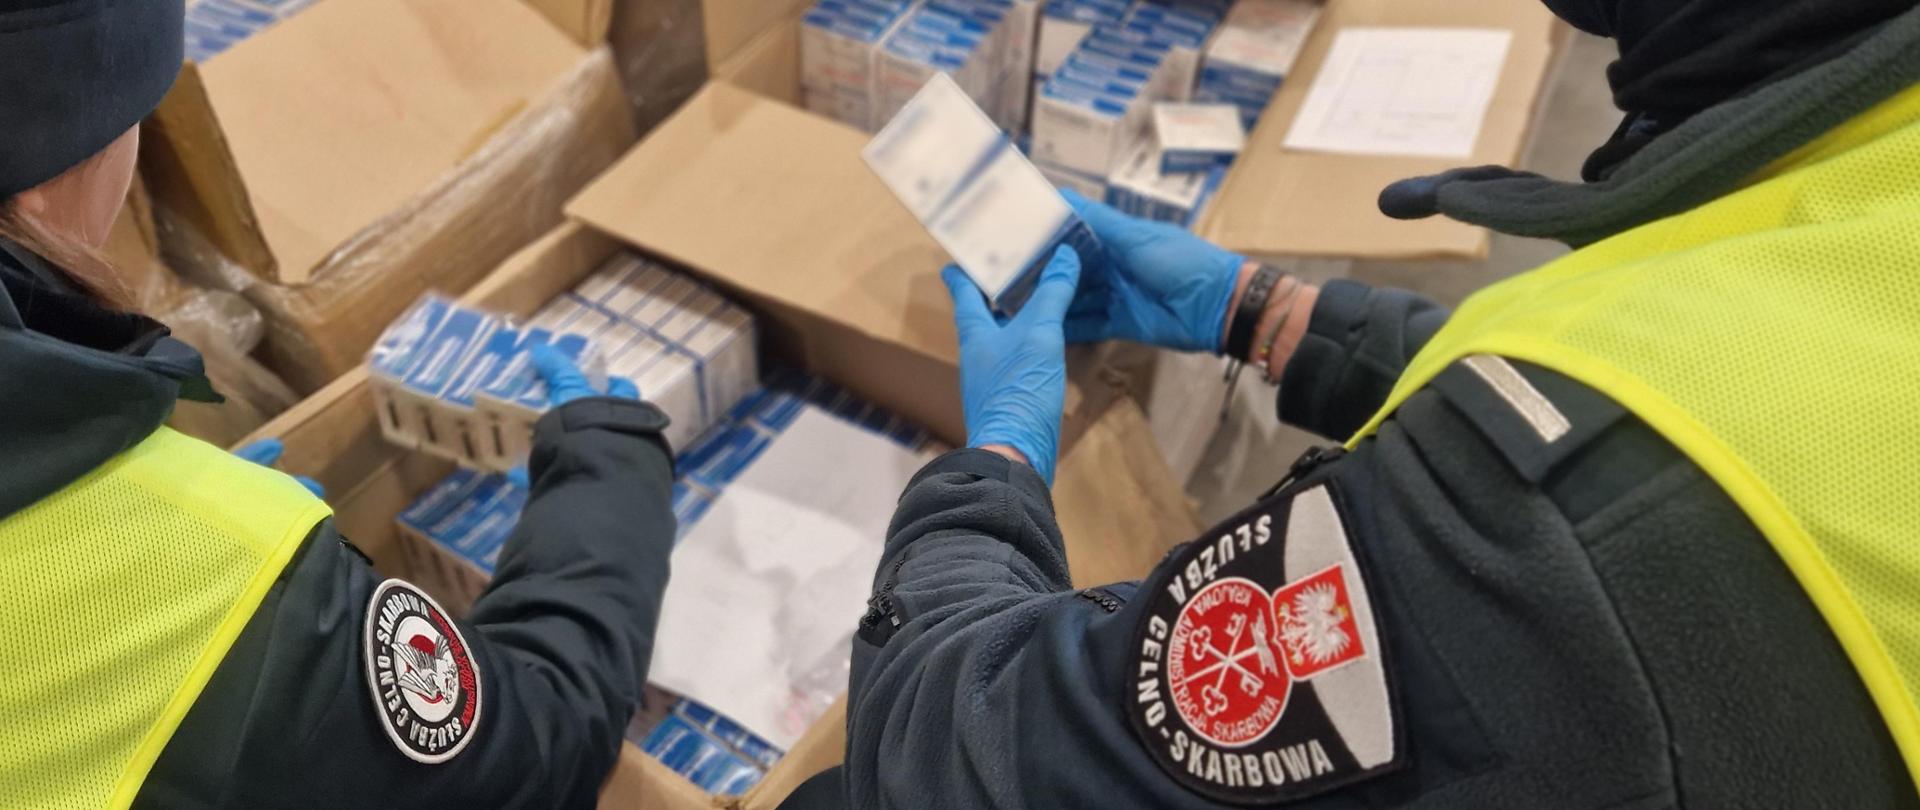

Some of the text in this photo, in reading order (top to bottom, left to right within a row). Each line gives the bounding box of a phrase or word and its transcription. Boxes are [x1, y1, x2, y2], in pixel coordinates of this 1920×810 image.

[376, 592, 430, 728] CELNO-SKARBOWA
[1137, 514, 1335, 788] SŁUŻBA CELNO-SKARBOWA
[408, 716, 463, 752] SŁUŻBA
